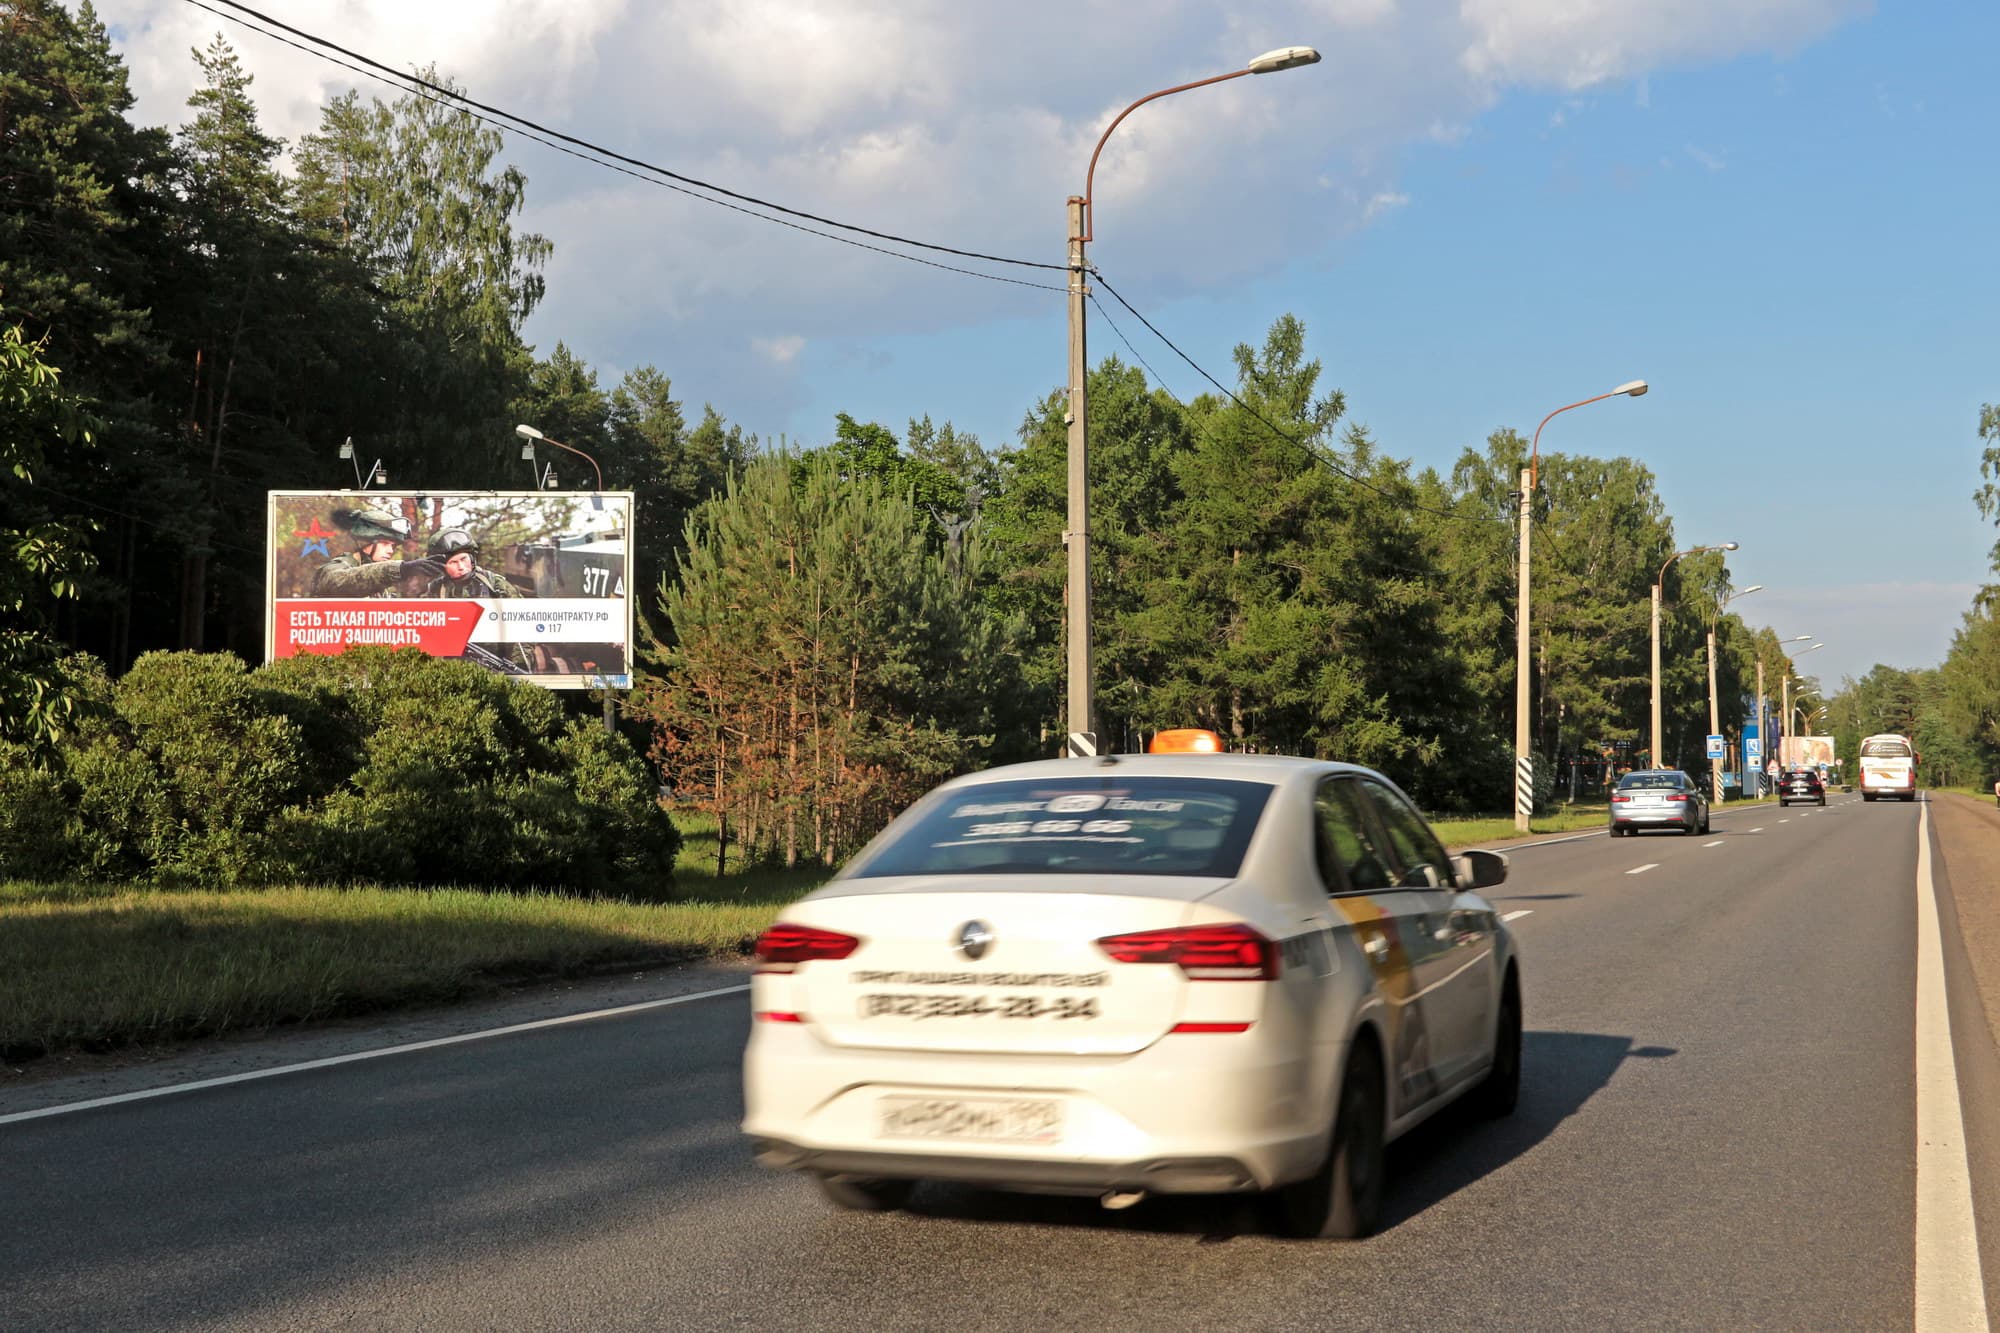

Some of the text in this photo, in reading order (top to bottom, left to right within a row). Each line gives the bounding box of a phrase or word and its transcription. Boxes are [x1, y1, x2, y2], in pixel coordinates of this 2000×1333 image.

[583, 566, 610, 598] 377
[289, 611, 322, 627] ЕСТЬ
[324, 611, 366, 627] ТАКАЯ
[368, 611, 446, 627] ПРОФЕССИЯ
[501, 611, 609, 622] СЛУЖБАПОКОНТРАКТУ.РФ
[548, 623, 562, 633] 117
[289, 628, 421, 645] РОДИНУ ЗАЩИЩАТЬ
